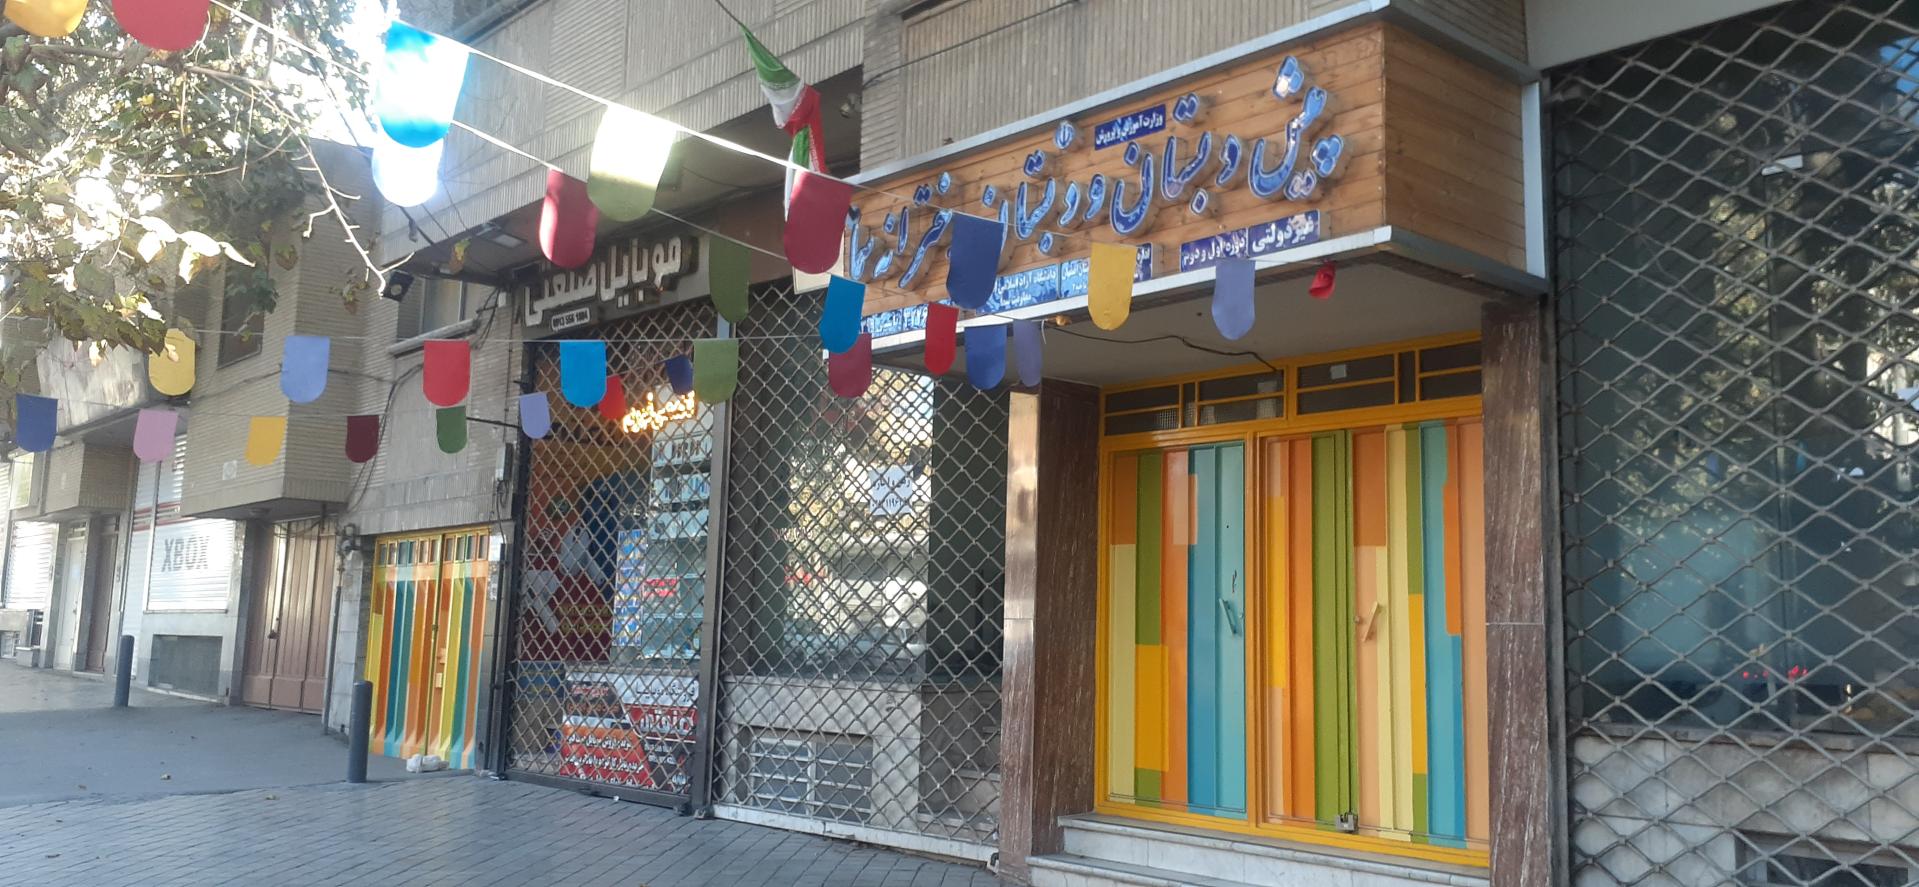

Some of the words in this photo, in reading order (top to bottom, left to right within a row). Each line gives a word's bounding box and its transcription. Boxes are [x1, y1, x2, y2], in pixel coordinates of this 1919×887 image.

[1142, 112, 1163, 130] وزارت
[1248, 55, 1344, 201] پیش
[1110, 92, 1241, 236] دبستان
[1083, 172, 1106, 221] و
[873, 171, 951, 288] خترانه
[1207, 237, 1223, 260] اول
[1225, 235, 1246, 256] دوره
[600, 236, 682, 308] موبایل
[1183, 247, 1200, 266] دوم
[524, 262, 597, 328] صنعتی
[160, 534, 210, 573] XBOX
